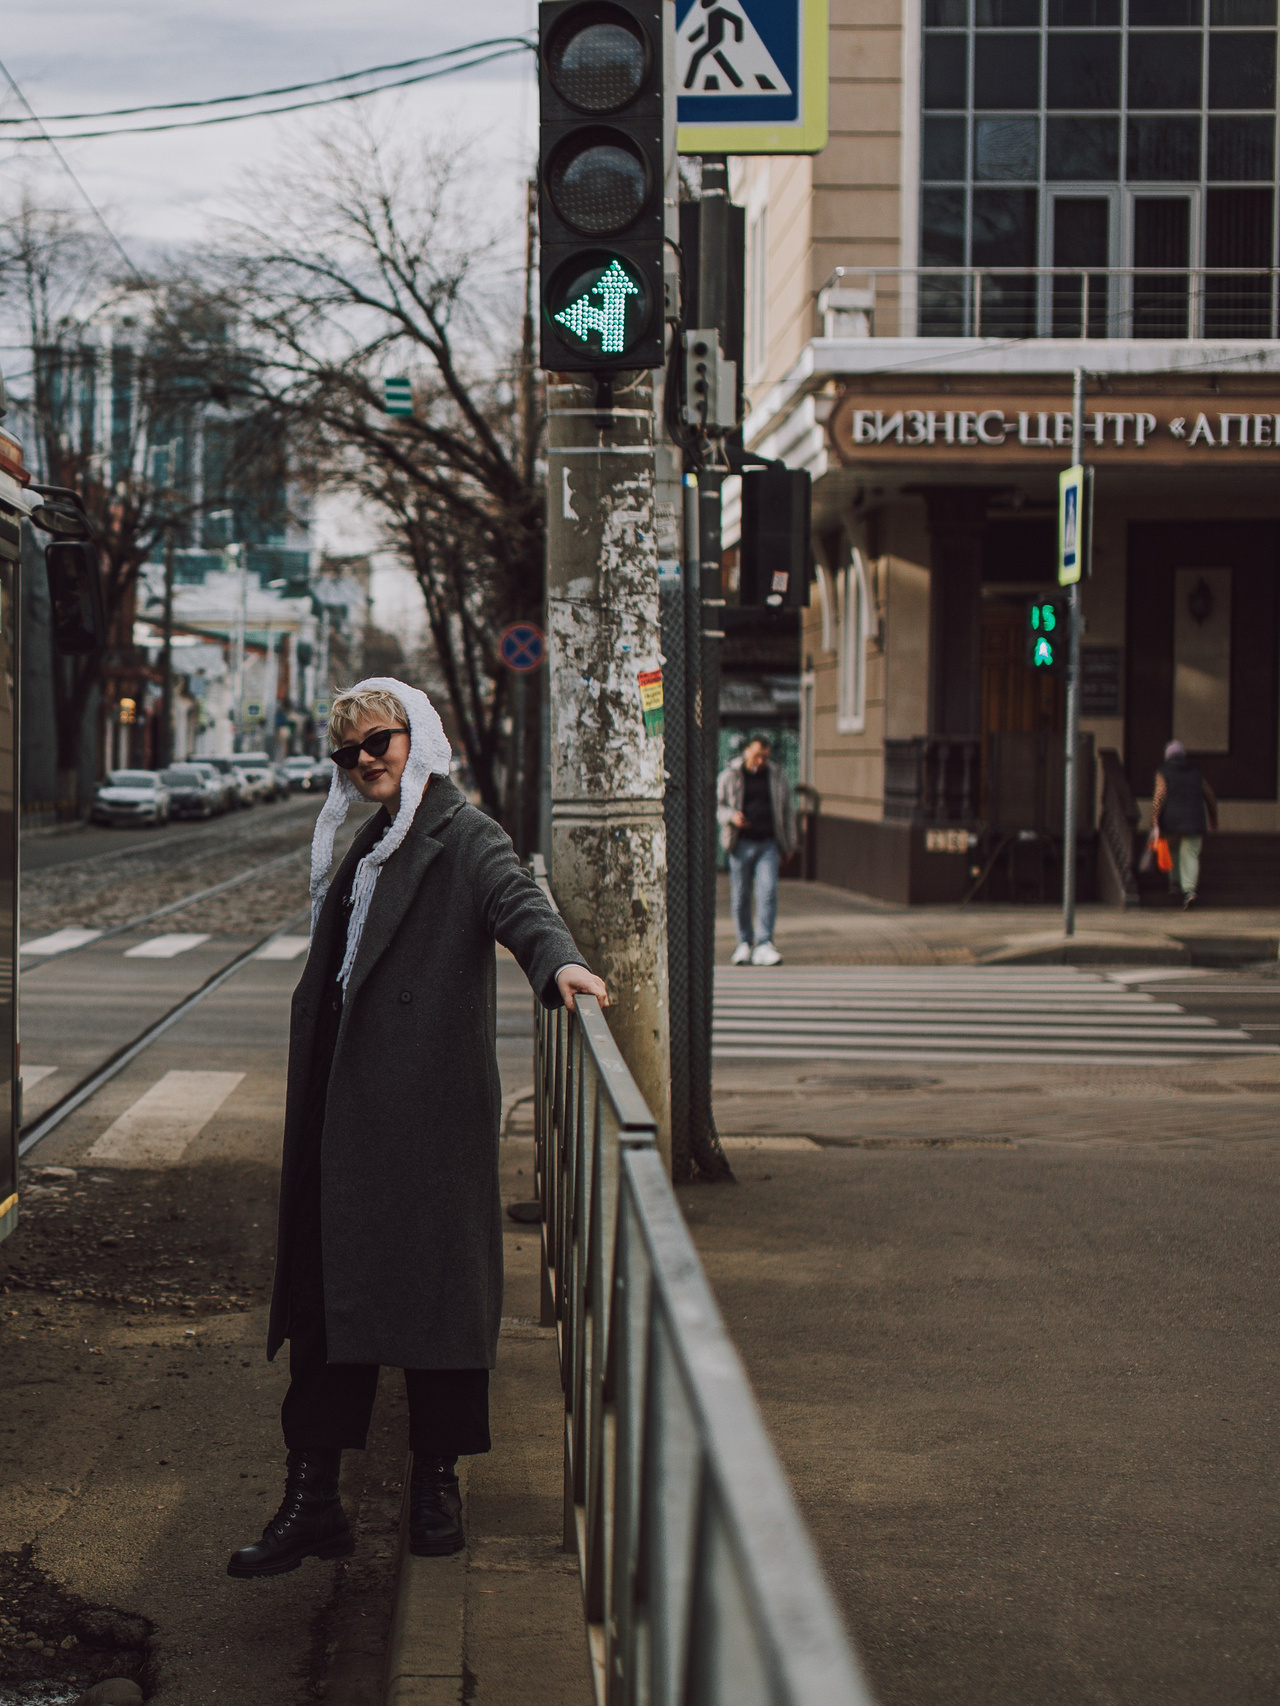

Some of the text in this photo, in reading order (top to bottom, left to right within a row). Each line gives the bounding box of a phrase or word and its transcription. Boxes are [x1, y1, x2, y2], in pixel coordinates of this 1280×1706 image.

[851, 408, 1280, 449] БИЗНЕС-ЦЕНТР «АПЕ
[1031, 604, 1056, 632] 15
